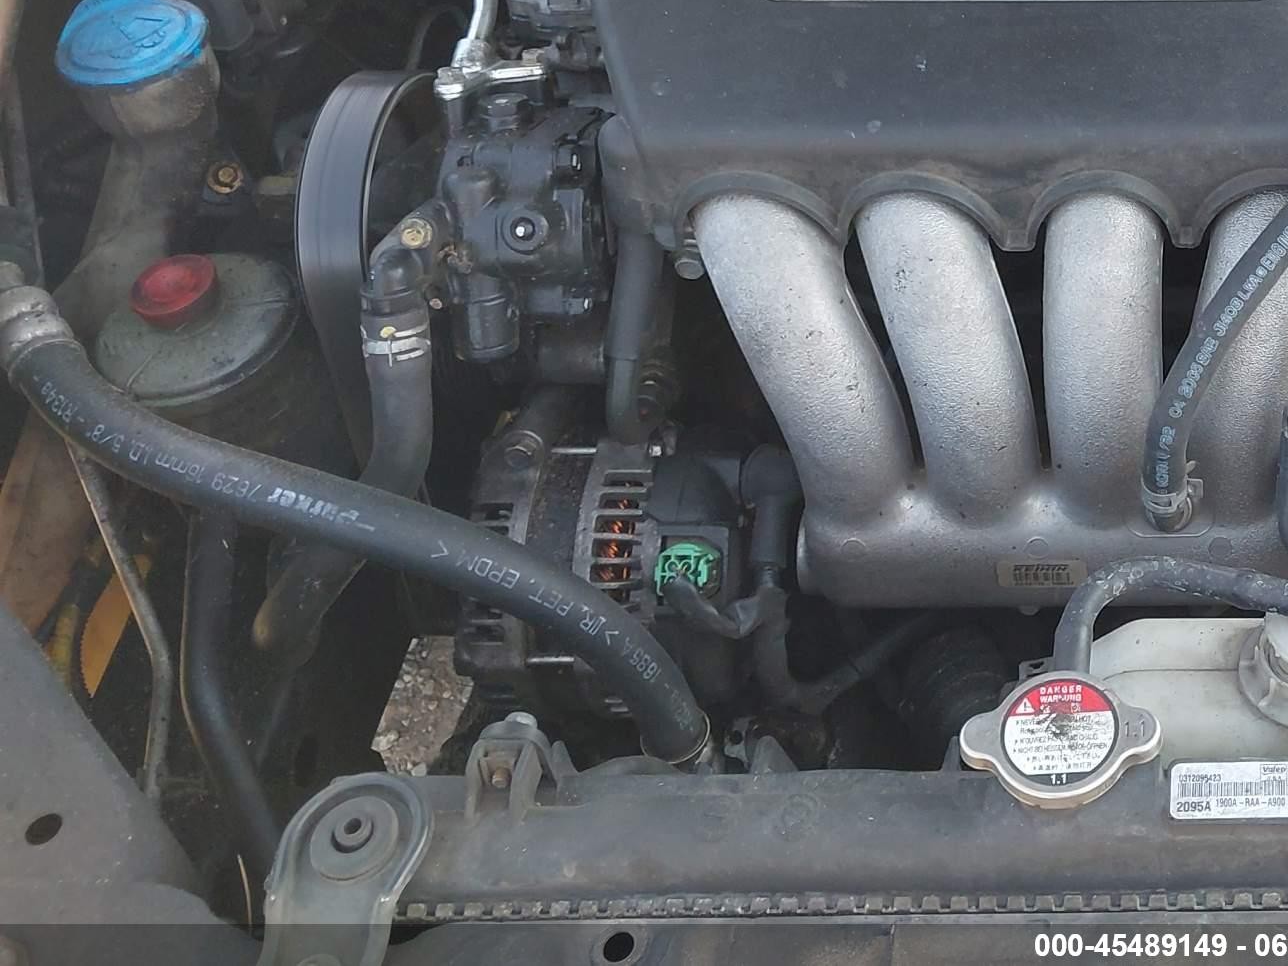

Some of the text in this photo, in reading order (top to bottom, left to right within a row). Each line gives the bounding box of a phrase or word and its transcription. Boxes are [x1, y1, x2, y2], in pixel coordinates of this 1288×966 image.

[1040, 685, 1082, 695] DANGER
[1125, 719, 1147, 739] 1.1
[1050, 773, 1068, 785] 1.1
[1176, 801, 1212, 813] 2095A
